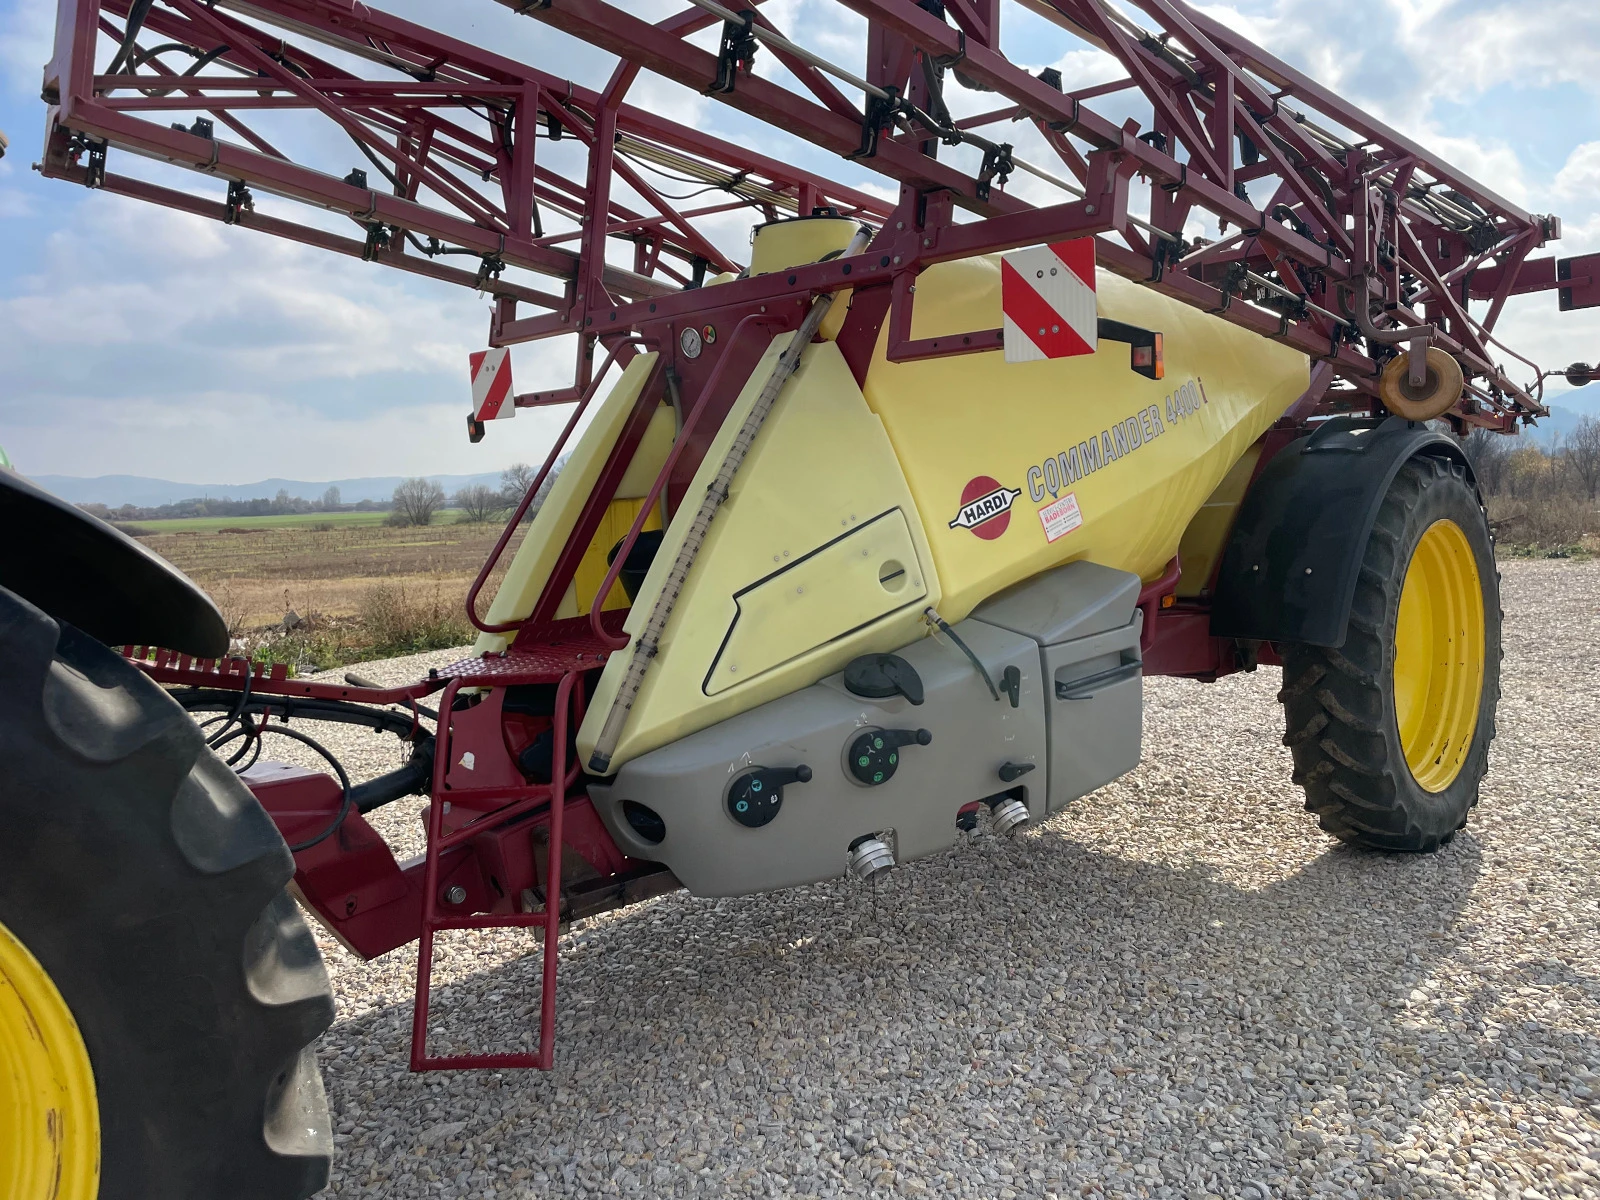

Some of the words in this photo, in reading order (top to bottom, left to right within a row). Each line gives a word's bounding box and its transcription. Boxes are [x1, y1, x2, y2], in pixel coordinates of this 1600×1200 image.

[1027, 404, 1165, 502] COMMANDER
[1165, 380, 1200, 425] 4400
[963, 492, 1008, 524] HARDI
